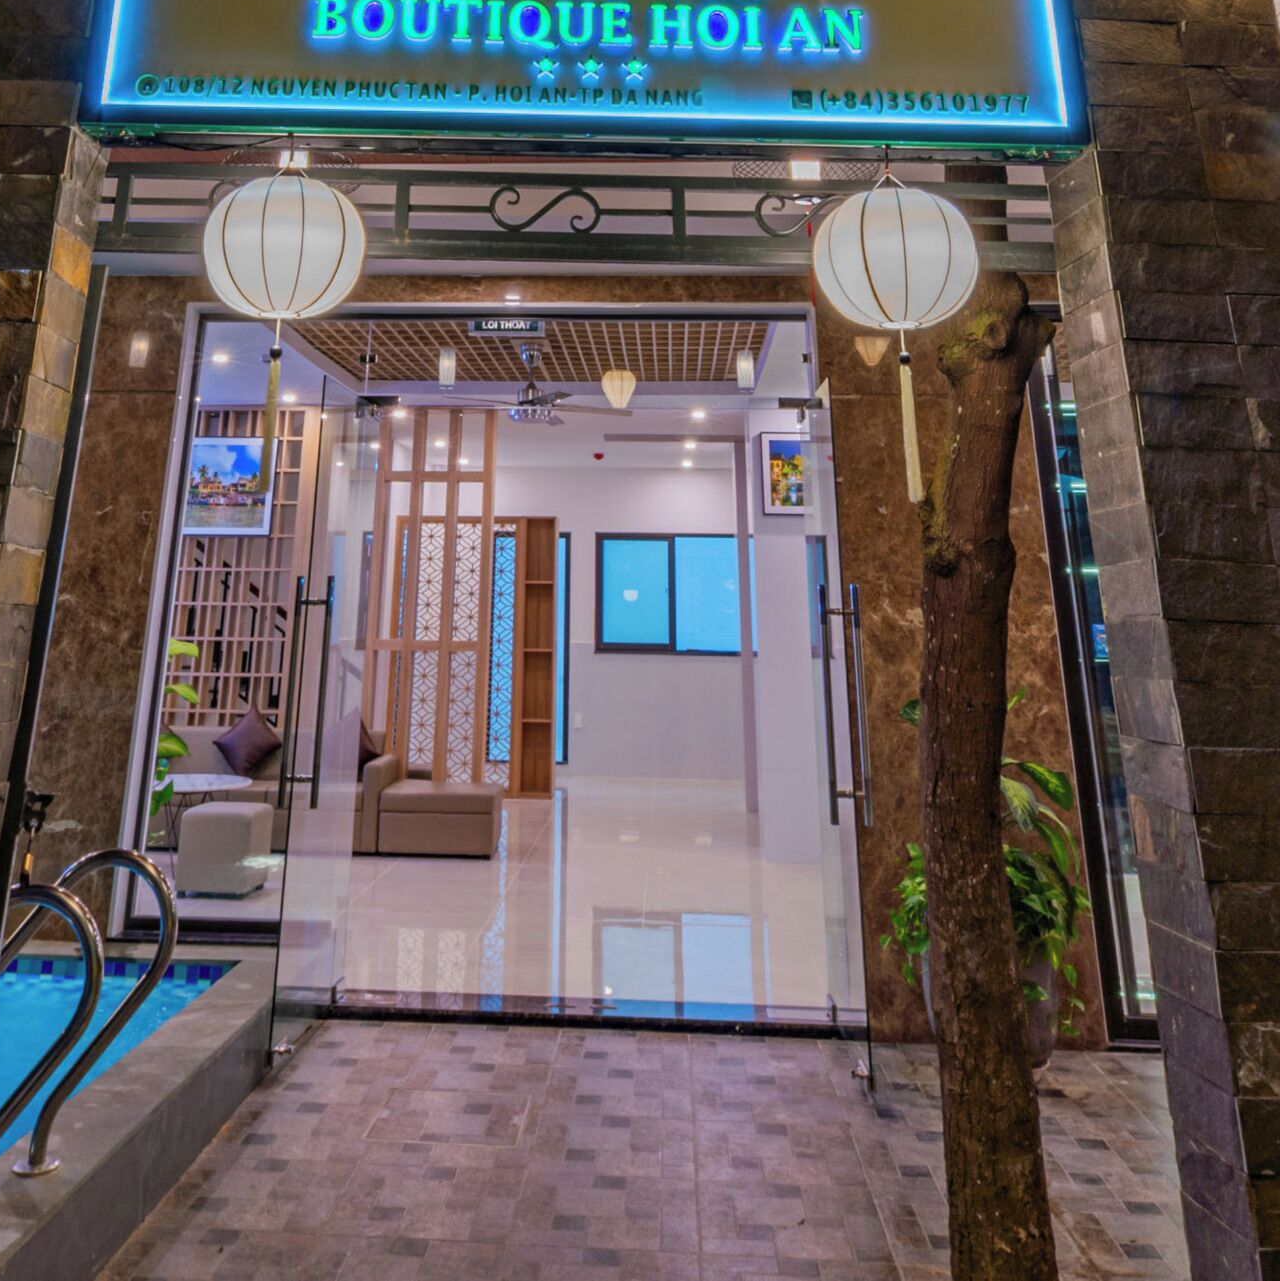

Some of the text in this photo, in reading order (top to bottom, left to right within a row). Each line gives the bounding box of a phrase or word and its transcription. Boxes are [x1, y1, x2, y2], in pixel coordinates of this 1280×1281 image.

[649, 3, 764, 50] HOI
[778, 7, 864, 53] AN
[163, 75, 243, 98] 108/12
[250, 78, 337, 99] NGUYEN
[343, 80, 398, 100] PHUC
[405, 82, 448, 101] TAN
[467, 84, 488, 102] P.
[495, 85, 531, 103] HOI
[645, 89, 704, 107] NANG
[819, 88, 1030, 114] (+84)356101977
